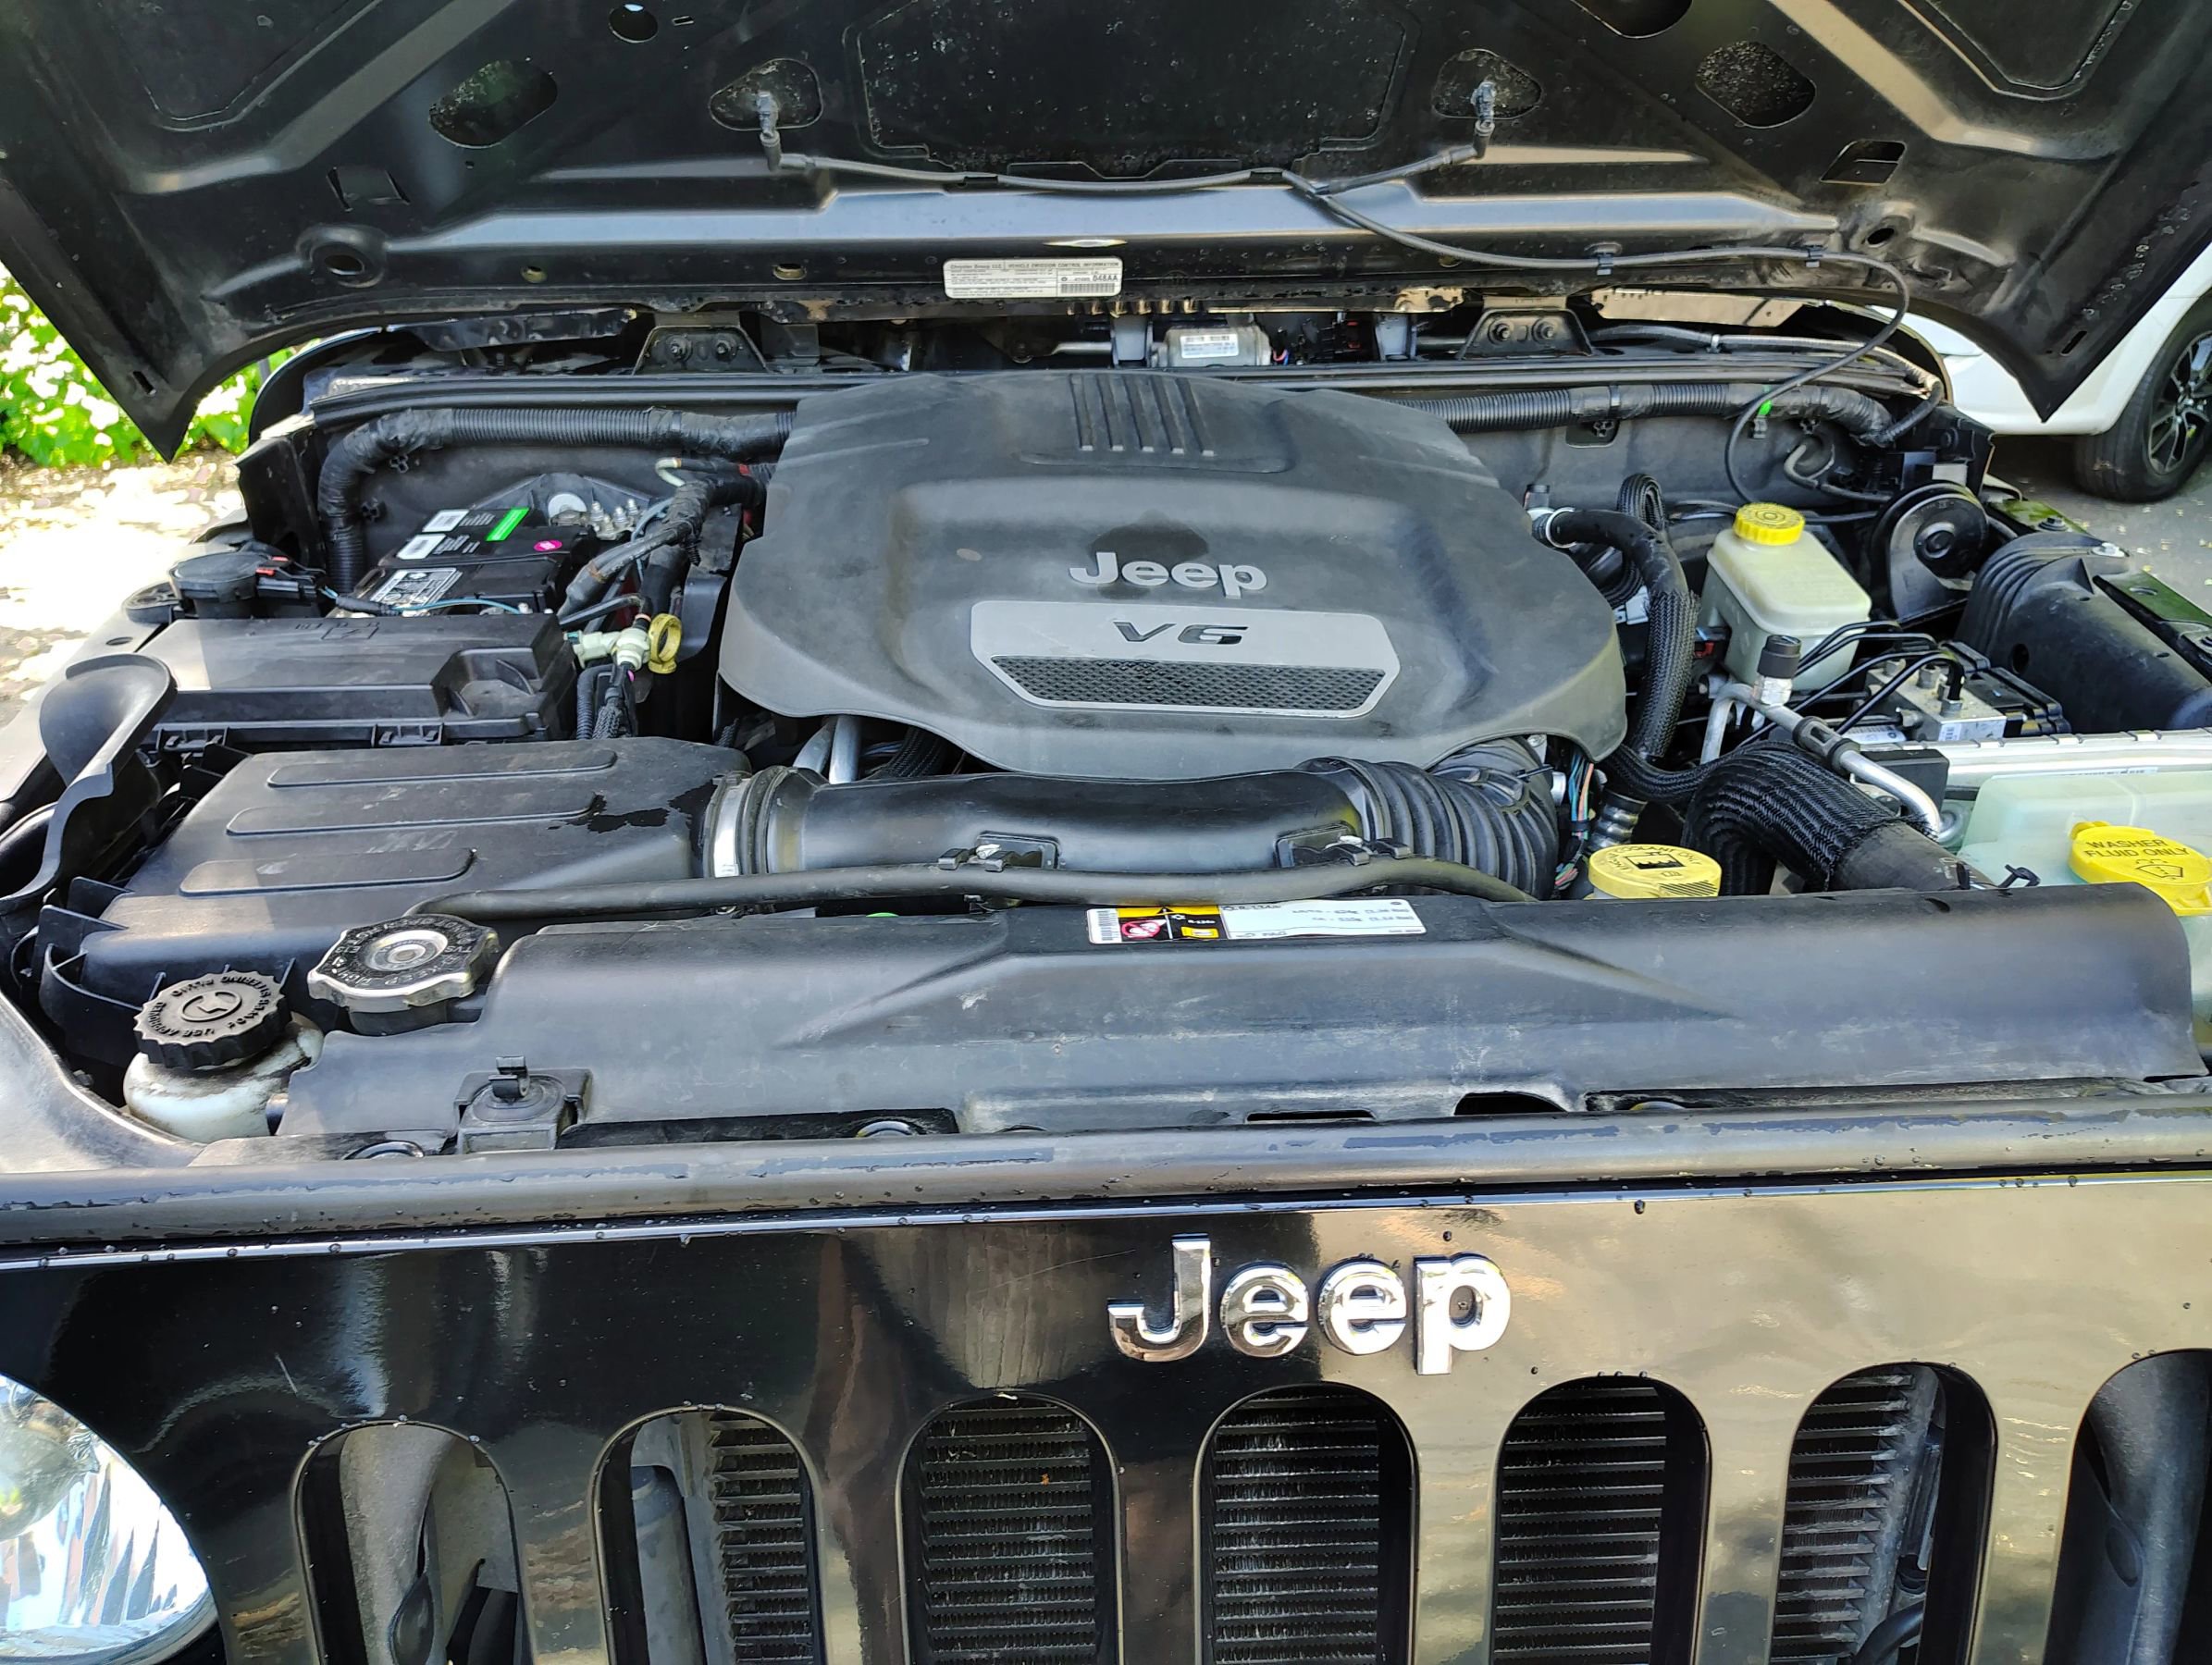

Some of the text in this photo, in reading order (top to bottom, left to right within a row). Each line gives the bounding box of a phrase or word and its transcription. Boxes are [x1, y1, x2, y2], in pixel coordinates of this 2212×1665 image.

[1069, 551, 1267, 599] Jeep
[1113, 621, 1248, 645] V6
[2084, 847, 2190, 857] FLUID ONLY
[2085, 840, 2168, 848] WASHER
[1107, 1233, 1512, 1375] Jeep
